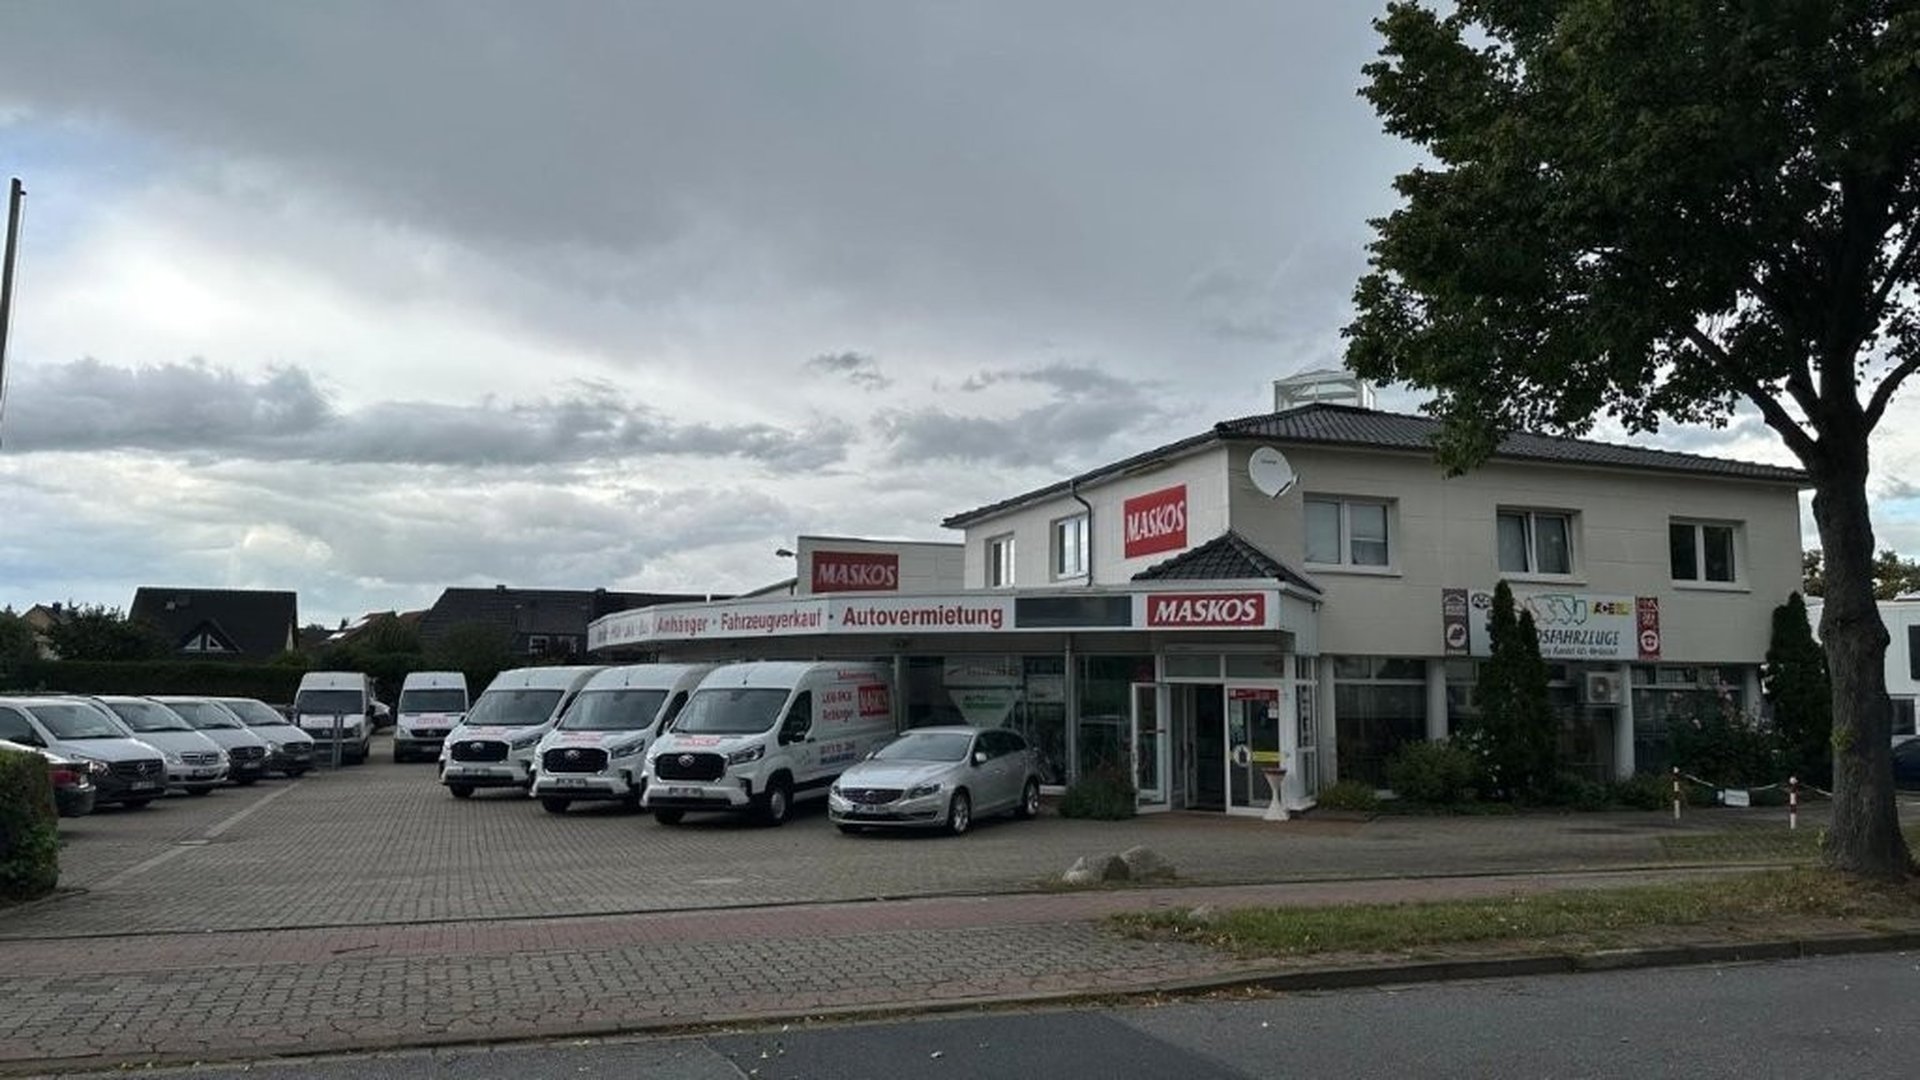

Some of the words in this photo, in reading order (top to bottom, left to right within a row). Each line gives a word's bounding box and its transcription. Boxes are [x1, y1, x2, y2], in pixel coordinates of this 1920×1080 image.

[1126, 500, 1185, 544] MASKOS
[817, 563, 897, 586] MASKOS
[656, 615, 709, 636] Anhänger
[721, 607, 822, 633] Fahrzeugverkauf
[842, 604, 1003, 630] Autovermietung
[1153, 598, 1257, 623] MASKOS
